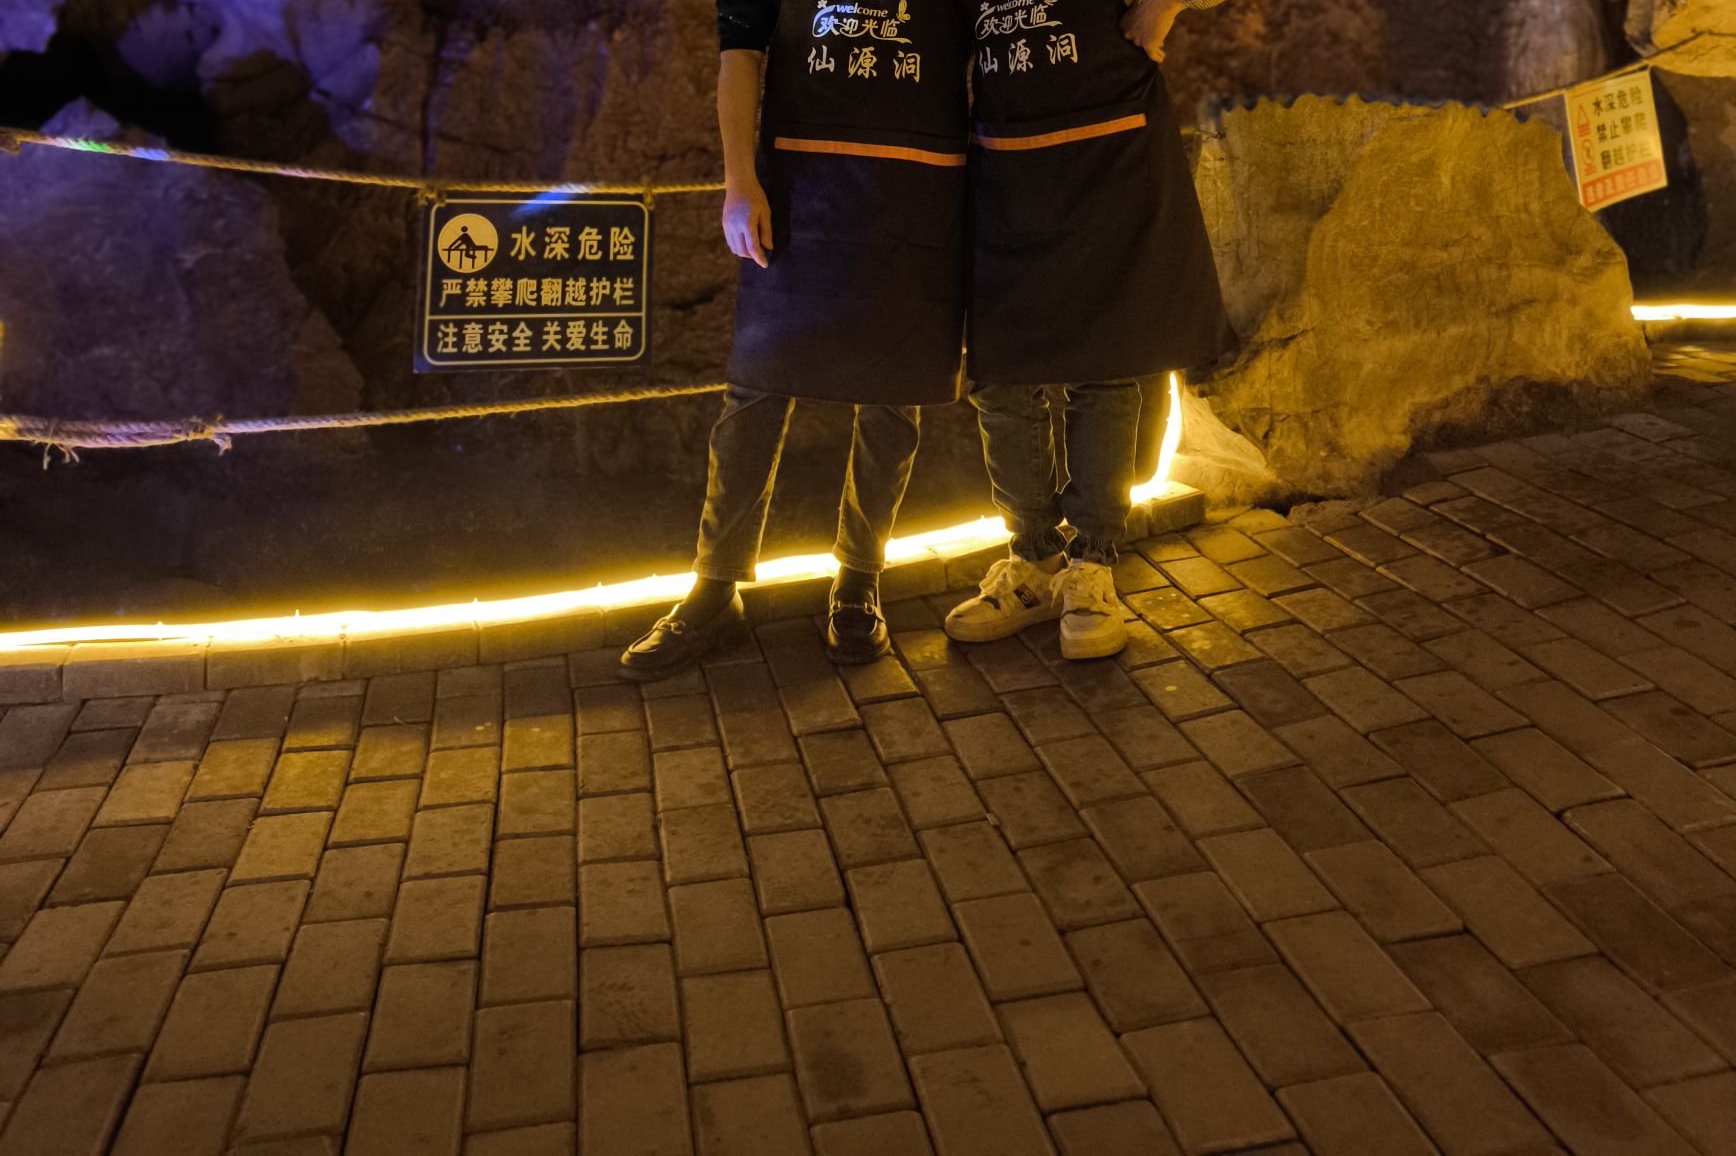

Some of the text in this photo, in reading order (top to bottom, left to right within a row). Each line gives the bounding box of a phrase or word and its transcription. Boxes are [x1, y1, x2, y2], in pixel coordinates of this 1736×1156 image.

[835, 2, 889, 18] welcome
[980, 4, 1049, 36] 欢迎光临
[816, 16, 901, 39] 欢迎光临
[807, 44, 922, 83] 仙源洞
[978, 32, 1079, 77] 仙源洞
[1592, 85, 1643, 116] 水深危险
[509, 225, 636, 261] 水深危险
[439, 276, 635, 309] 严禁攀爬翻越护栏
[436, 318, 634, 354] 注意安全 关爱生命
